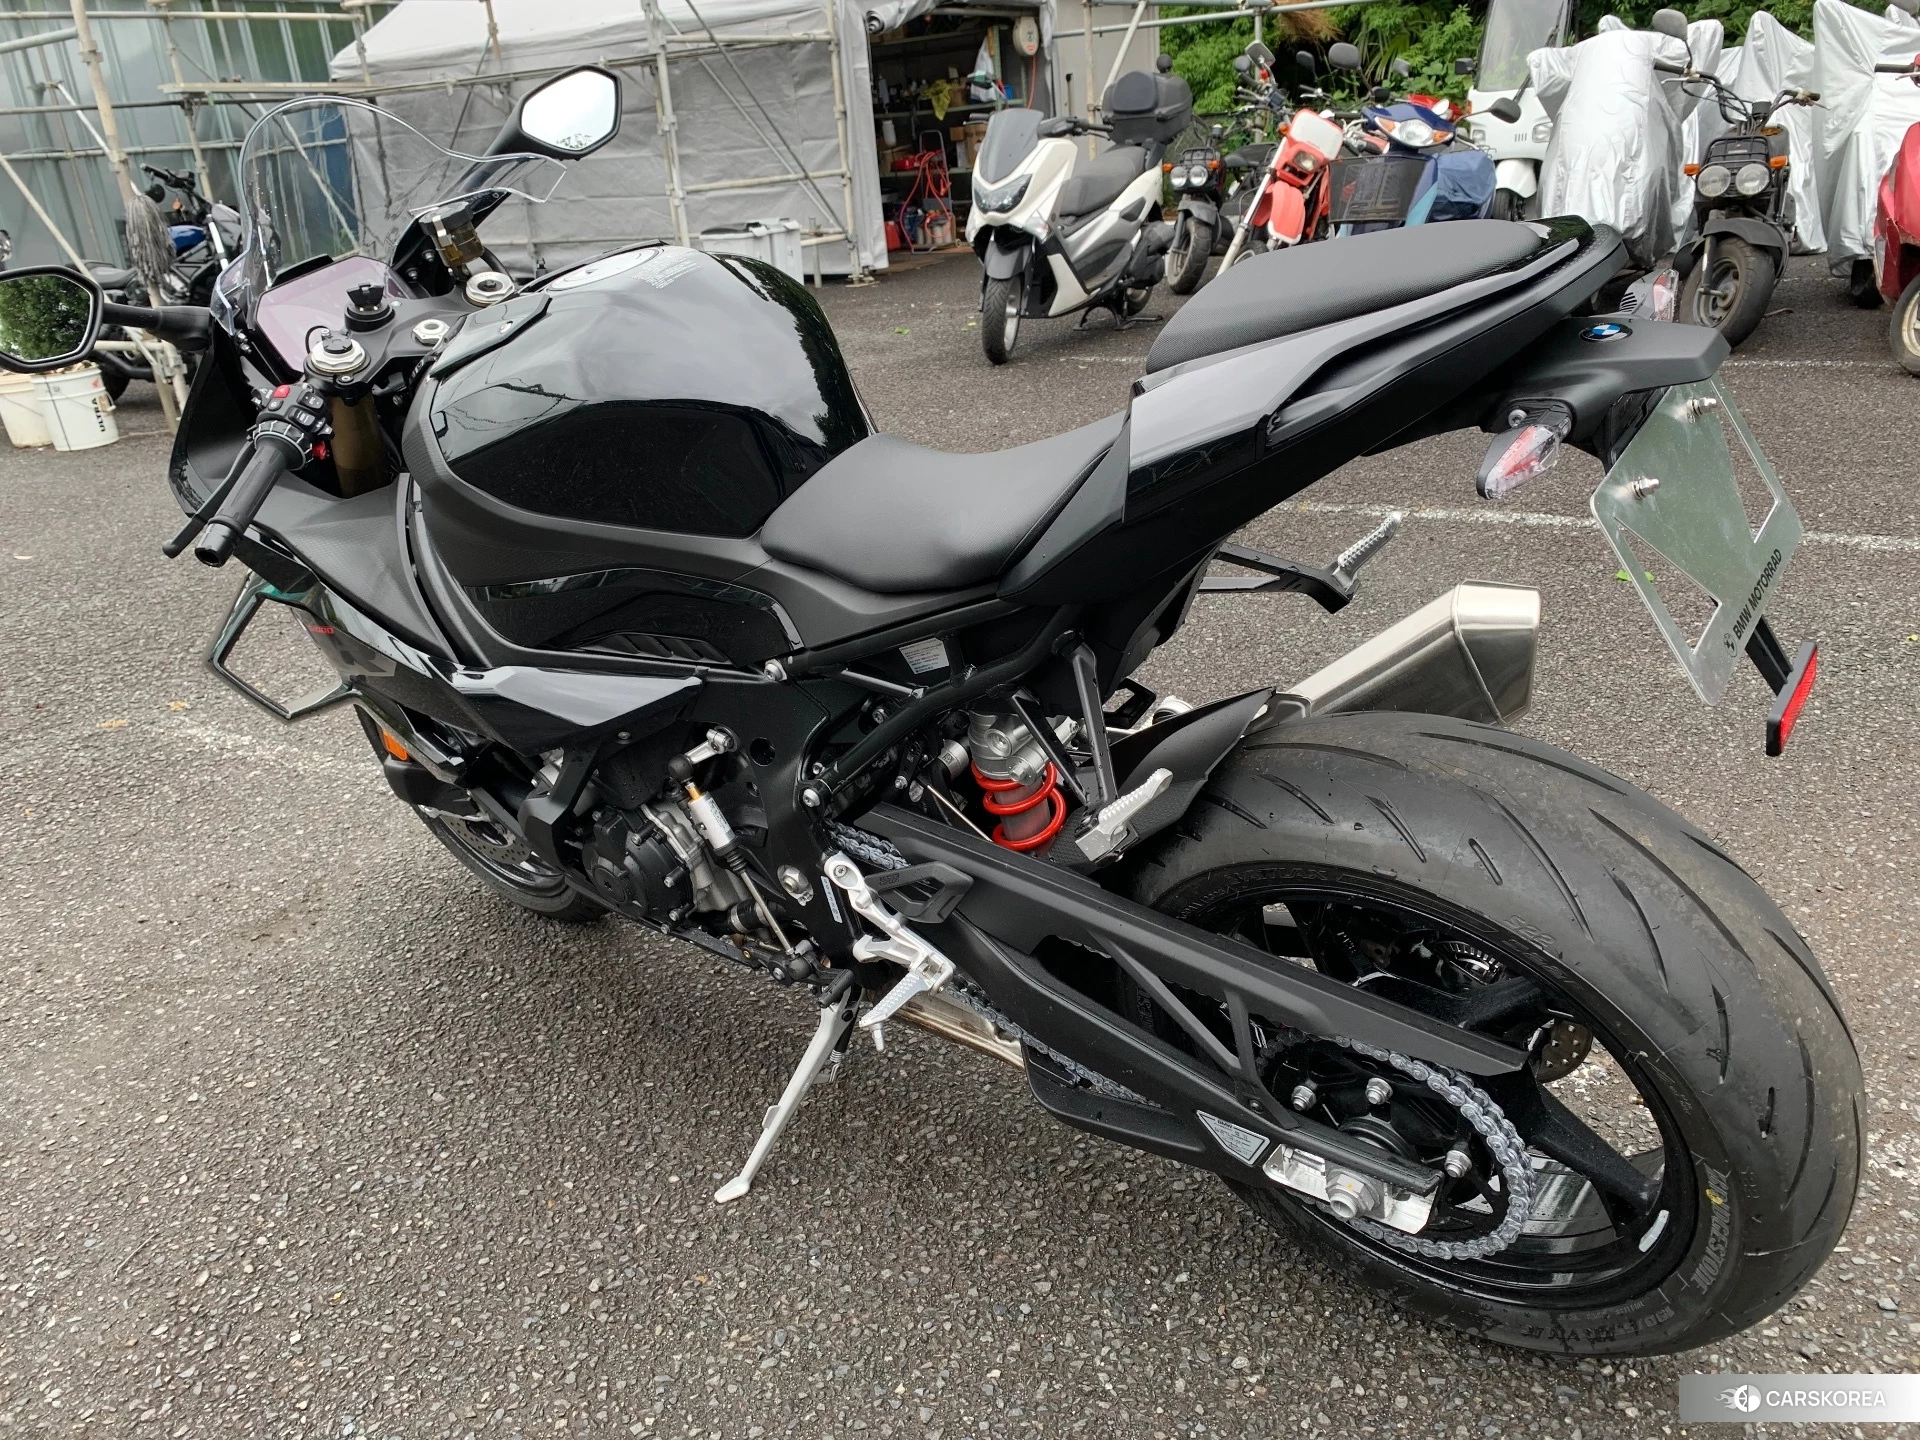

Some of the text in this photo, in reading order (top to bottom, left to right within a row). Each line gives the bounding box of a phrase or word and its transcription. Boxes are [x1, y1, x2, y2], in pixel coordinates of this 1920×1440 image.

[91, 397, 106, 432] ULTRA
[1733, 548, 1782, 640] BMW MOTORRAD
[1690, 1162, 1731, 1296] BRIDGESTONE
